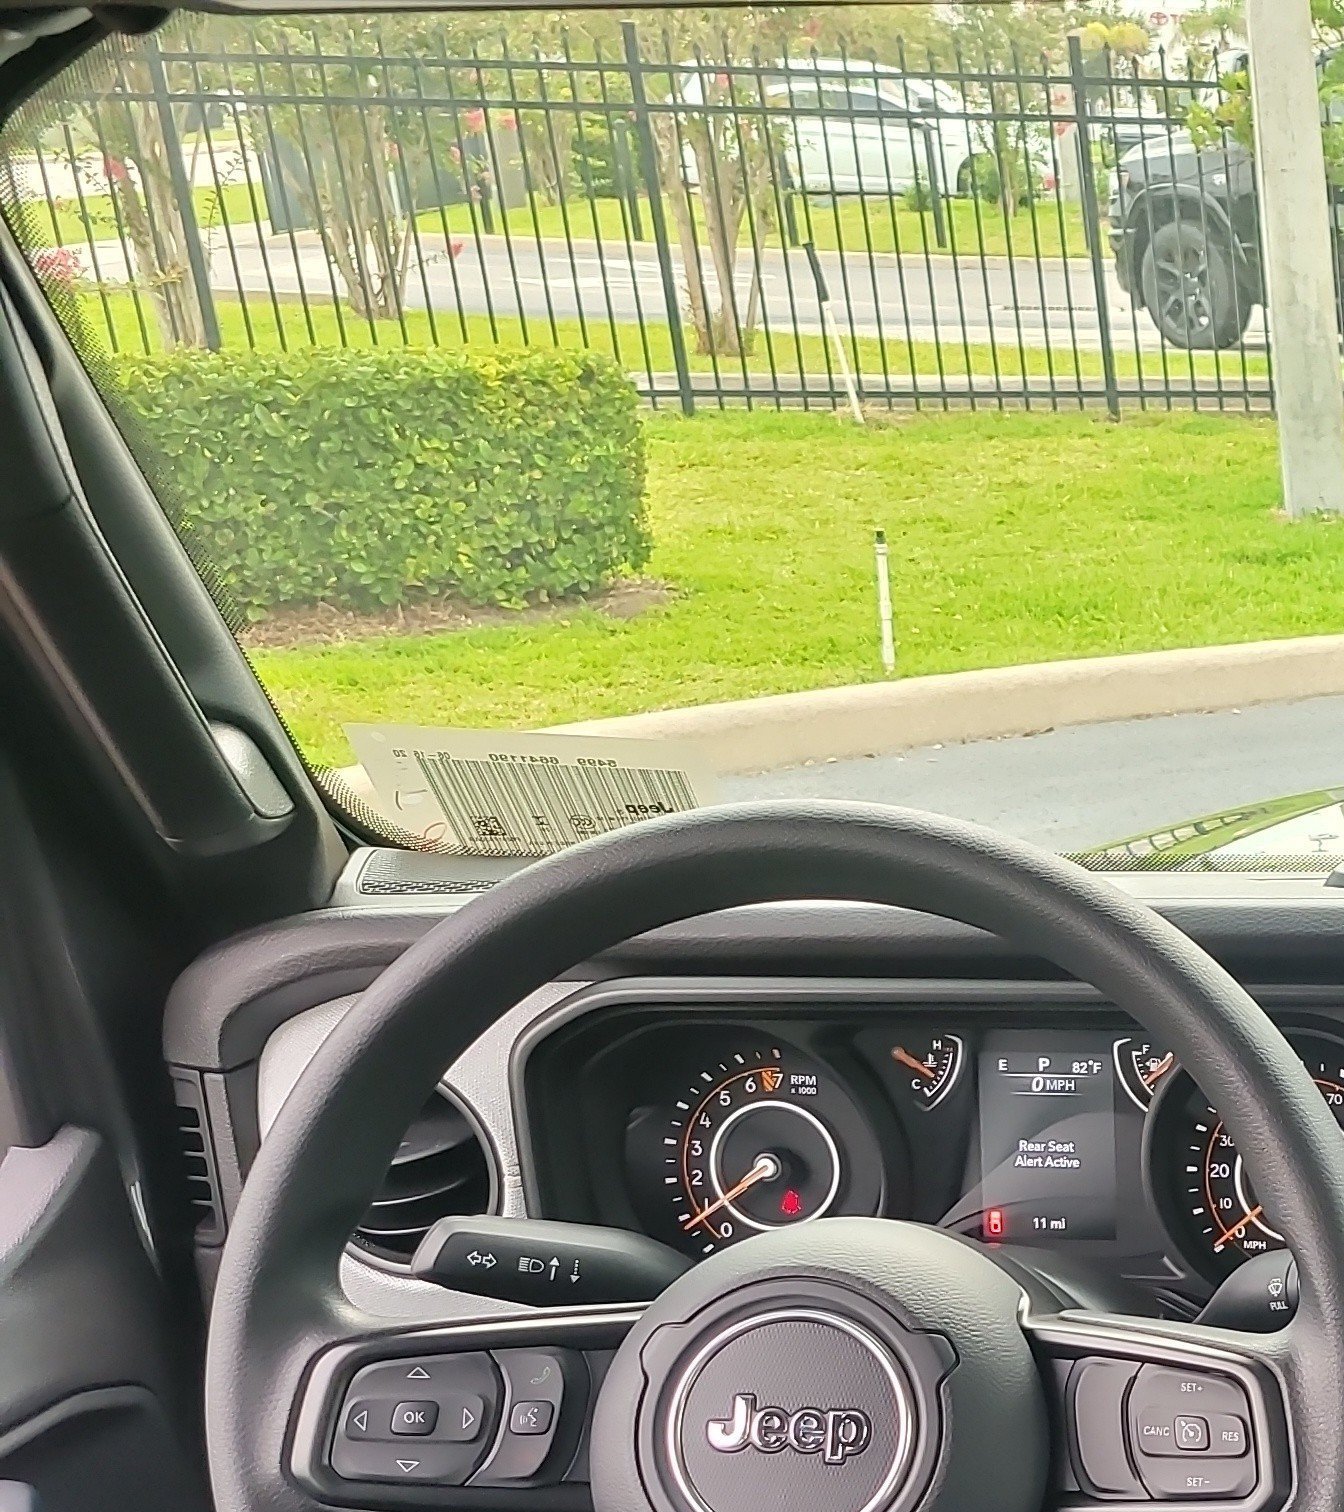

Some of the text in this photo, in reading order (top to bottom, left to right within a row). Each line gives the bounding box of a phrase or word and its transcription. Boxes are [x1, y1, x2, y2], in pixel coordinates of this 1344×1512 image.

[932, 1040, 942, 1050] H
[1142, 1044, 1151, 1054] F
[1039, 1058, 1050, 1071] P
[1072, 1060, 1101, 1074] 82°F
[745, 1077, 756, 1093] 6
[773, 1073, 783, 1088] 7
[790, 1075, 816, 1085] RPM
[911, 1079, 921, 1090] C
[1031, 1077, 1075, 1092] 0 MPH
[719, 1091, 731, 1106] 5
[1326, 1093, 1343, 1105] 70
[700, 1113, 711, 1128] 4
[691, 1141, 703, 1156] 3
[1019, 1140, 1075, 1153] Rear Seat
[1015, 1156, 1080, 1168] Alert Active
[692, 1170, 703, 1185] 2
[1210, 1164, 1229, 1178] 20
[1219, 1198, 1232, 1209] 10
[721, 1223, 733, 1237] 0
[1033, 1218, 1066, 1229] 11 mi
[1243, 1241, 1267, 1249] MPH
[404, 1410, 426, 1424] OK
[706, 1394, 872, 1466] Jeep
[1143, 1425, 1170, 1436] CANC
[1222, 1431, 1239, 1442] RES
